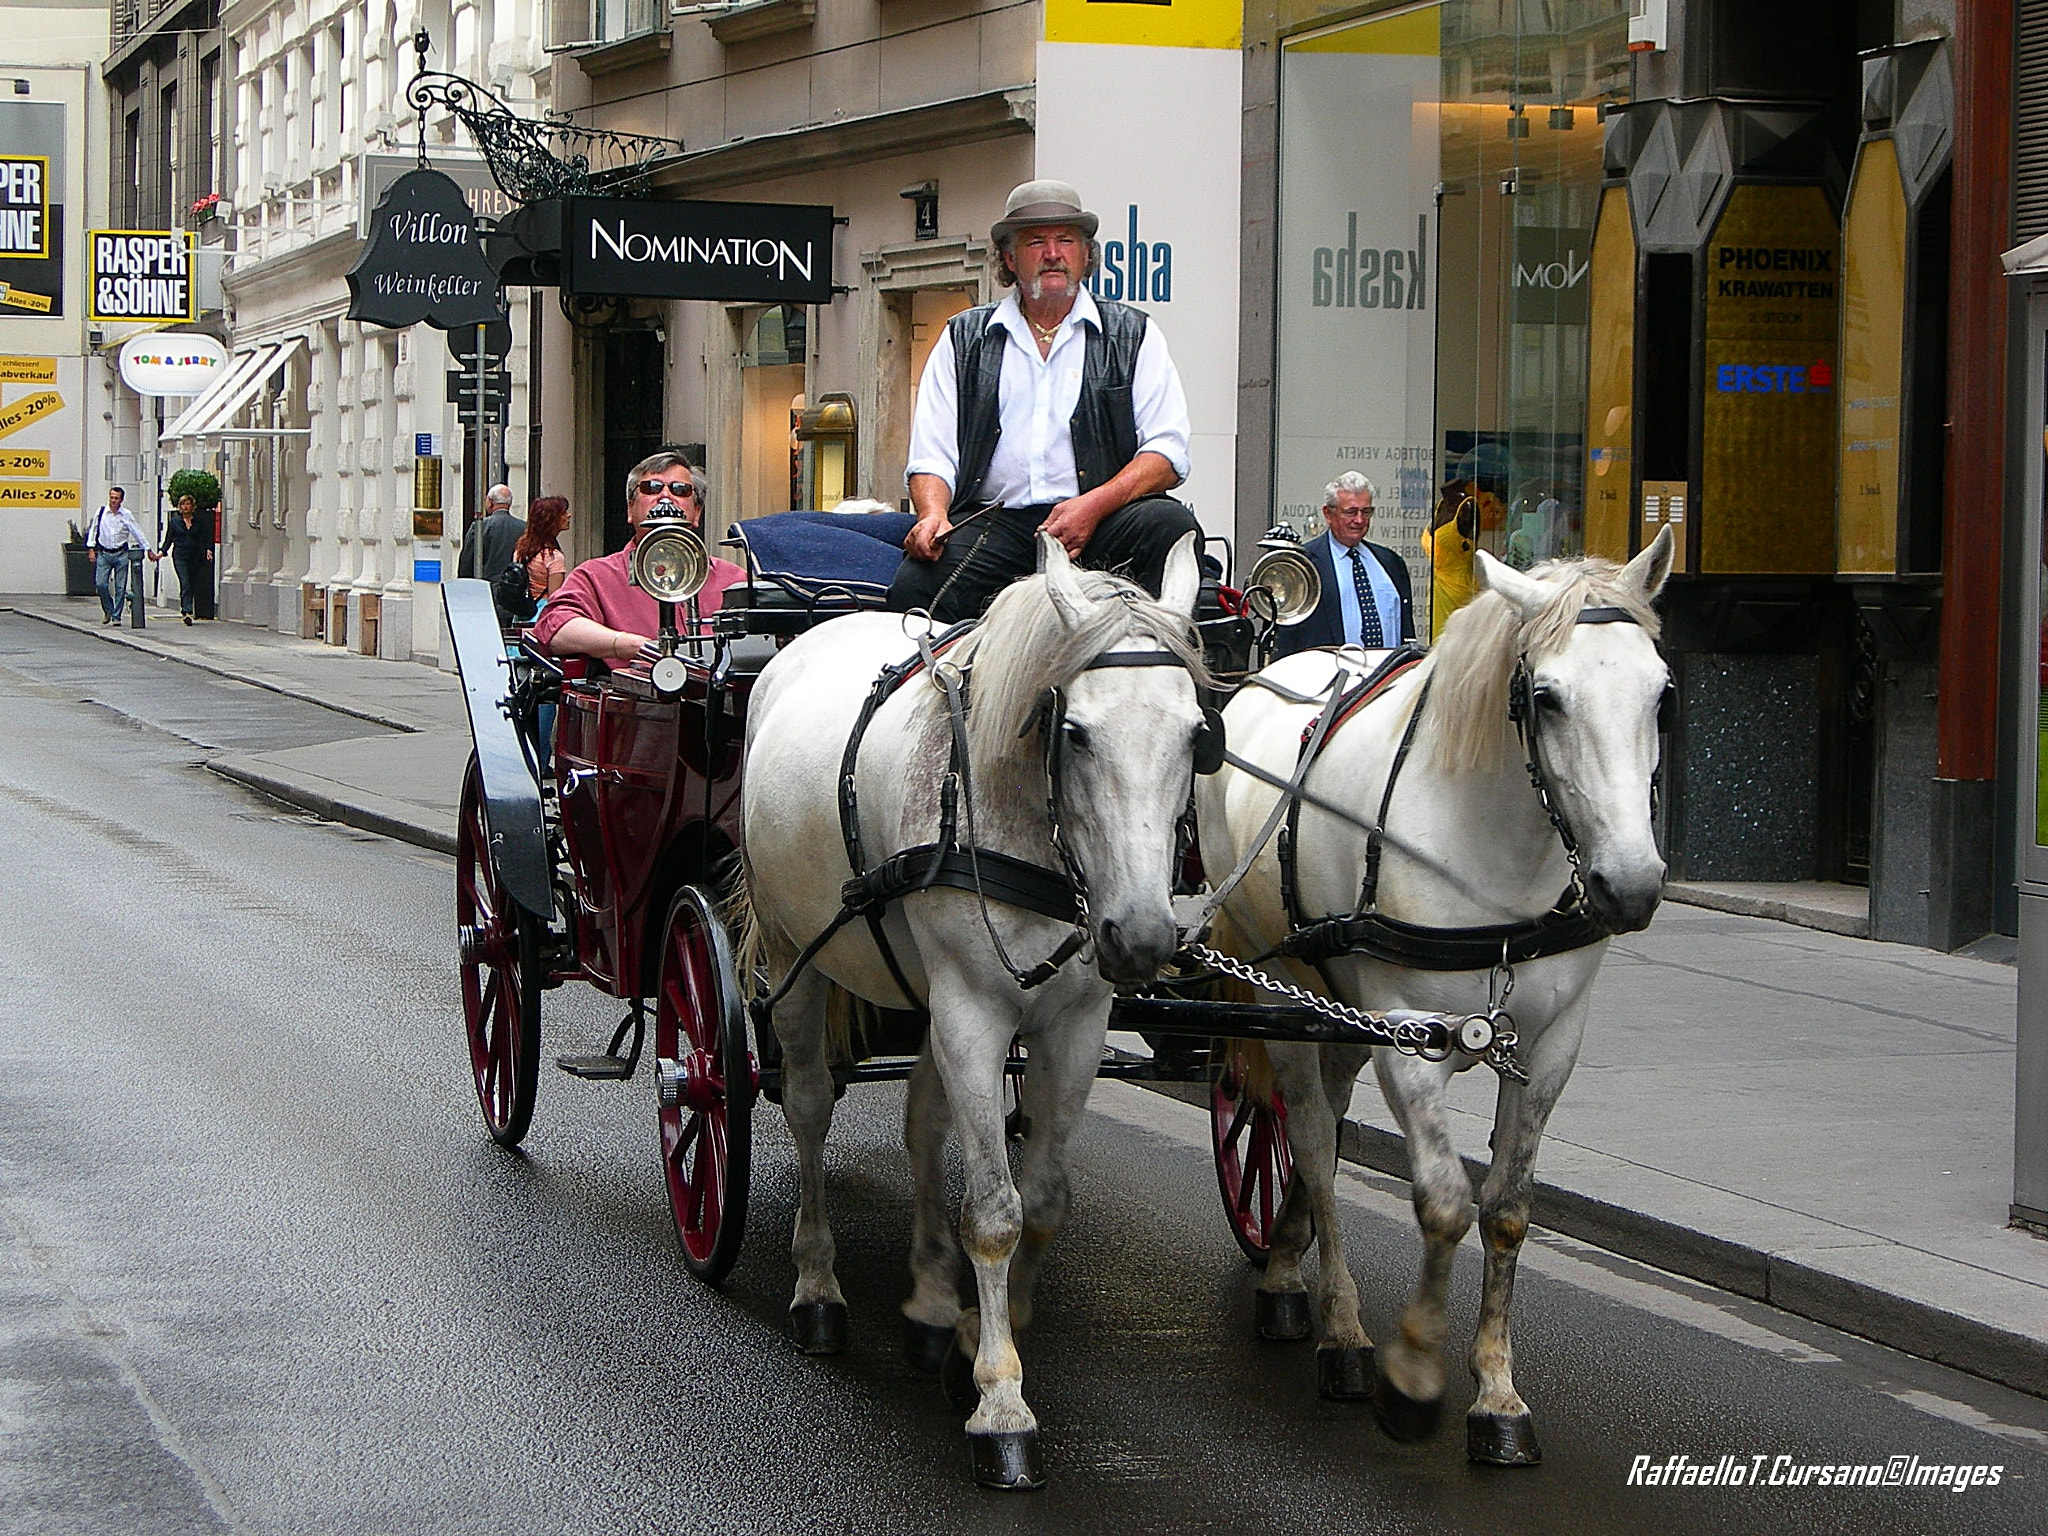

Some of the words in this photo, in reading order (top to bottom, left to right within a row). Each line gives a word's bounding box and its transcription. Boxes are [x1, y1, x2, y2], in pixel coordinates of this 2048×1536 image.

[921, 201, 931, 226] 4
[390, 210, 468, 245] Villon
[97, 236, 187, 275] RASPER
[1719, 247, 1832, 272] PHOENIX
[97, 273, 187, 316] &SÖHNE
[374, 271, 482, 304] Weinkeller
[1718, 280, 1834, 299] KRAWATTEN
[7, 296, 27, 306] Alles
[28, 299, 48, 310] -20%
[133, 354, 161, 366] TOM
[165, 356, 174, 366] &
[177, 355, 217, 367] JERRY
[1717, 364, 1807, 393] ERSTE
[23, 394, 56, 415] -20%
[9, 457, 45, 469] -20%
[1, 489, 37, 500] Alles
[39, 489, 76, 500] -20%
